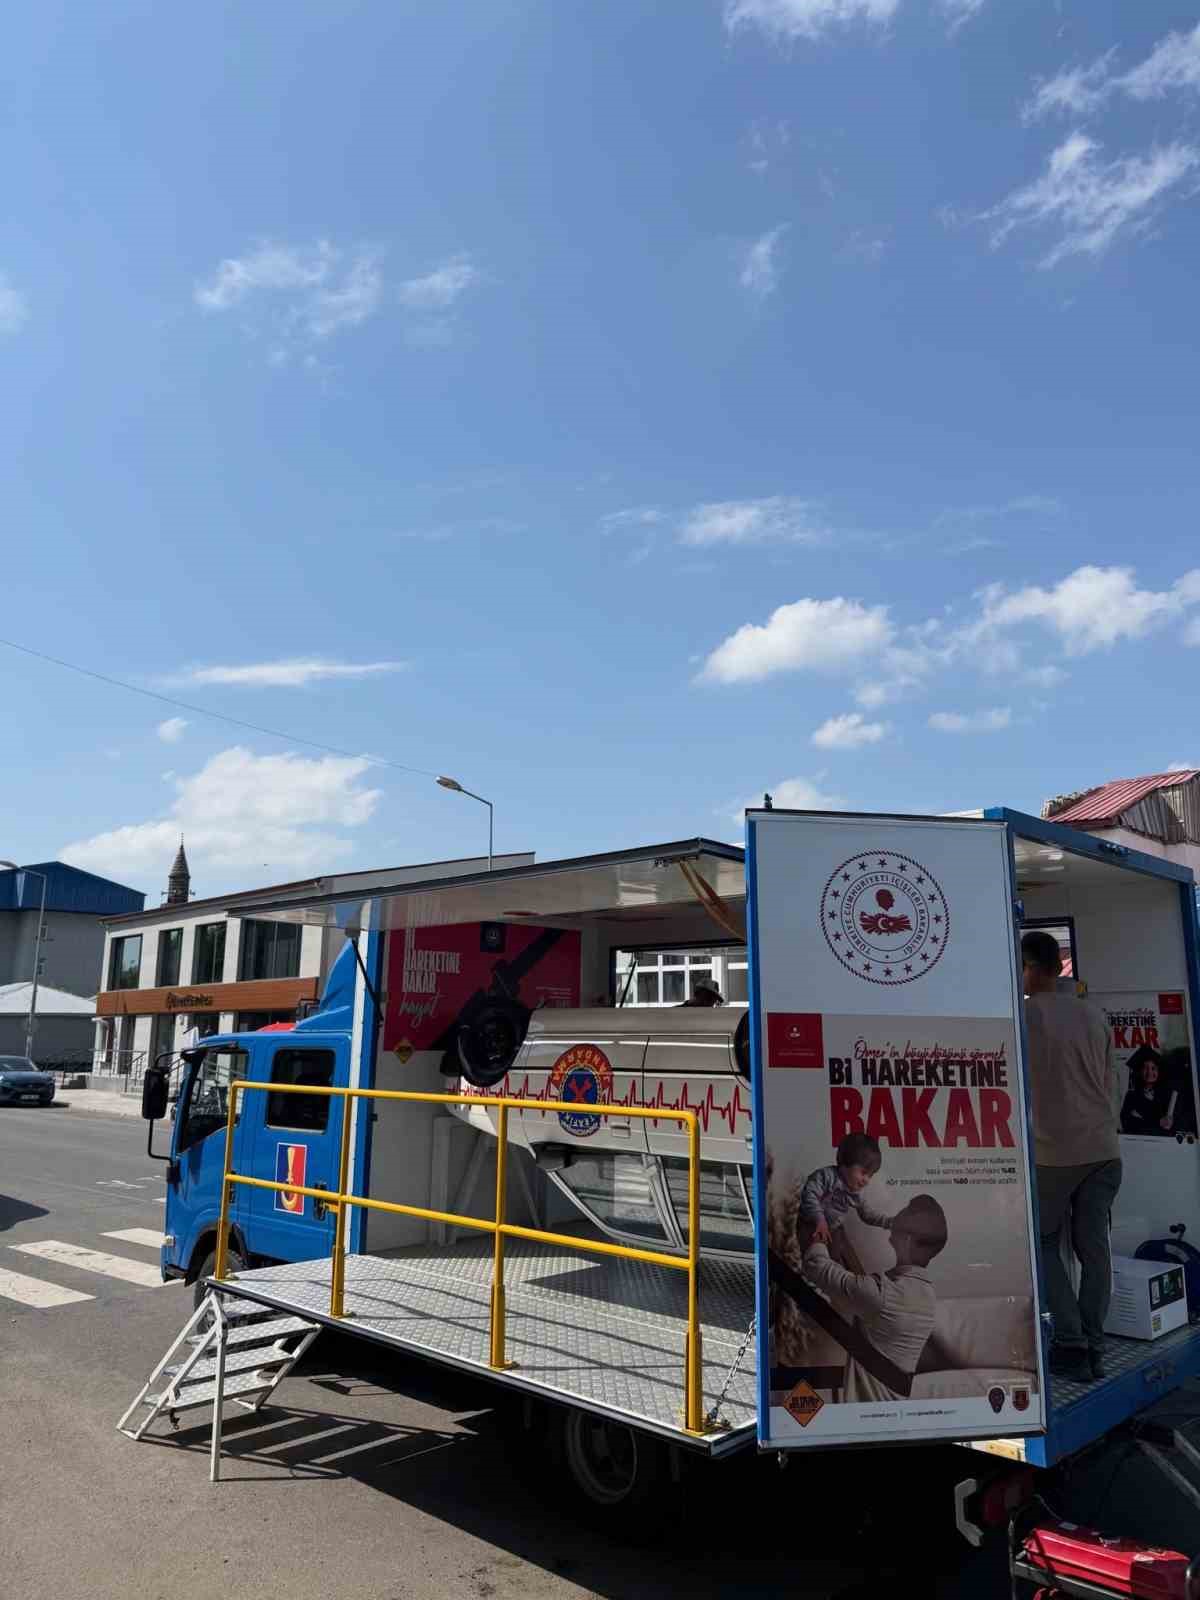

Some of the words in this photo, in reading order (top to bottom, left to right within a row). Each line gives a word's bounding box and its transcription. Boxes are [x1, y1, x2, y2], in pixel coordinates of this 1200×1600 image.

[1108, 1015, 1157, 1028] REKETİNE
[1114, 1027, 1160, 1049] KAR
[861, 1057, 1008, 1088] HAREKETİNE
[829, 1086, 1016, 1148] BAKAR
